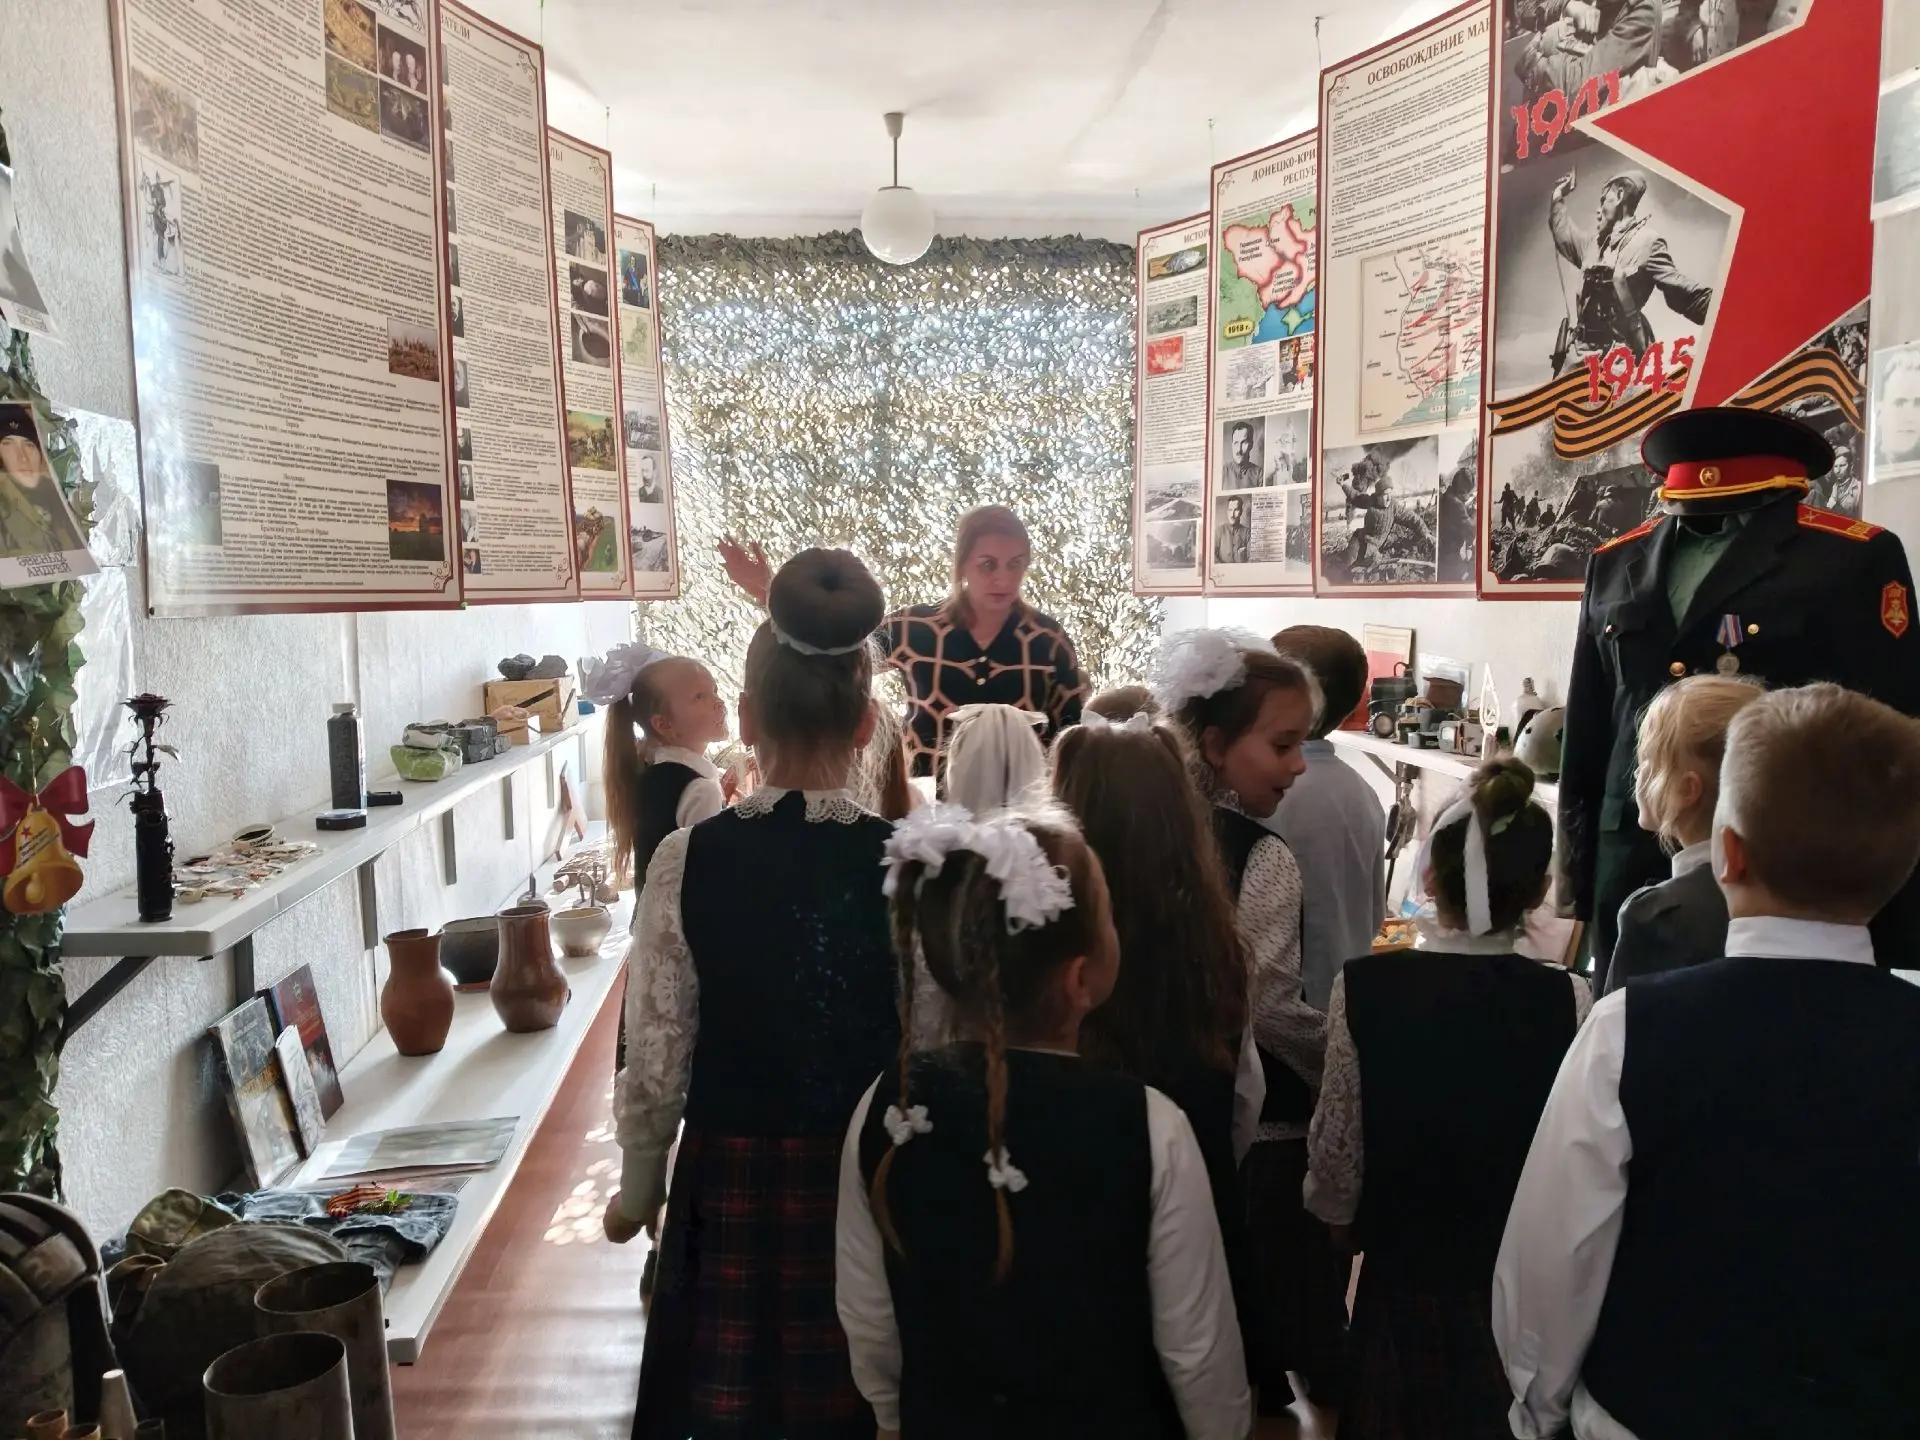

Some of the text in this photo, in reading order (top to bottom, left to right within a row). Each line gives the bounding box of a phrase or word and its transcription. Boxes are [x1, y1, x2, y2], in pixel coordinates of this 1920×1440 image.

[1367, 30, 1464, 86] ОСВОБОЖДЕНИЕ
[1511, 66, 1621, 159] 1941
[1251, 147, 1316, 182] ДОНЕЦКО-КРИ
[1584, 335, 1696, 404] 1945
